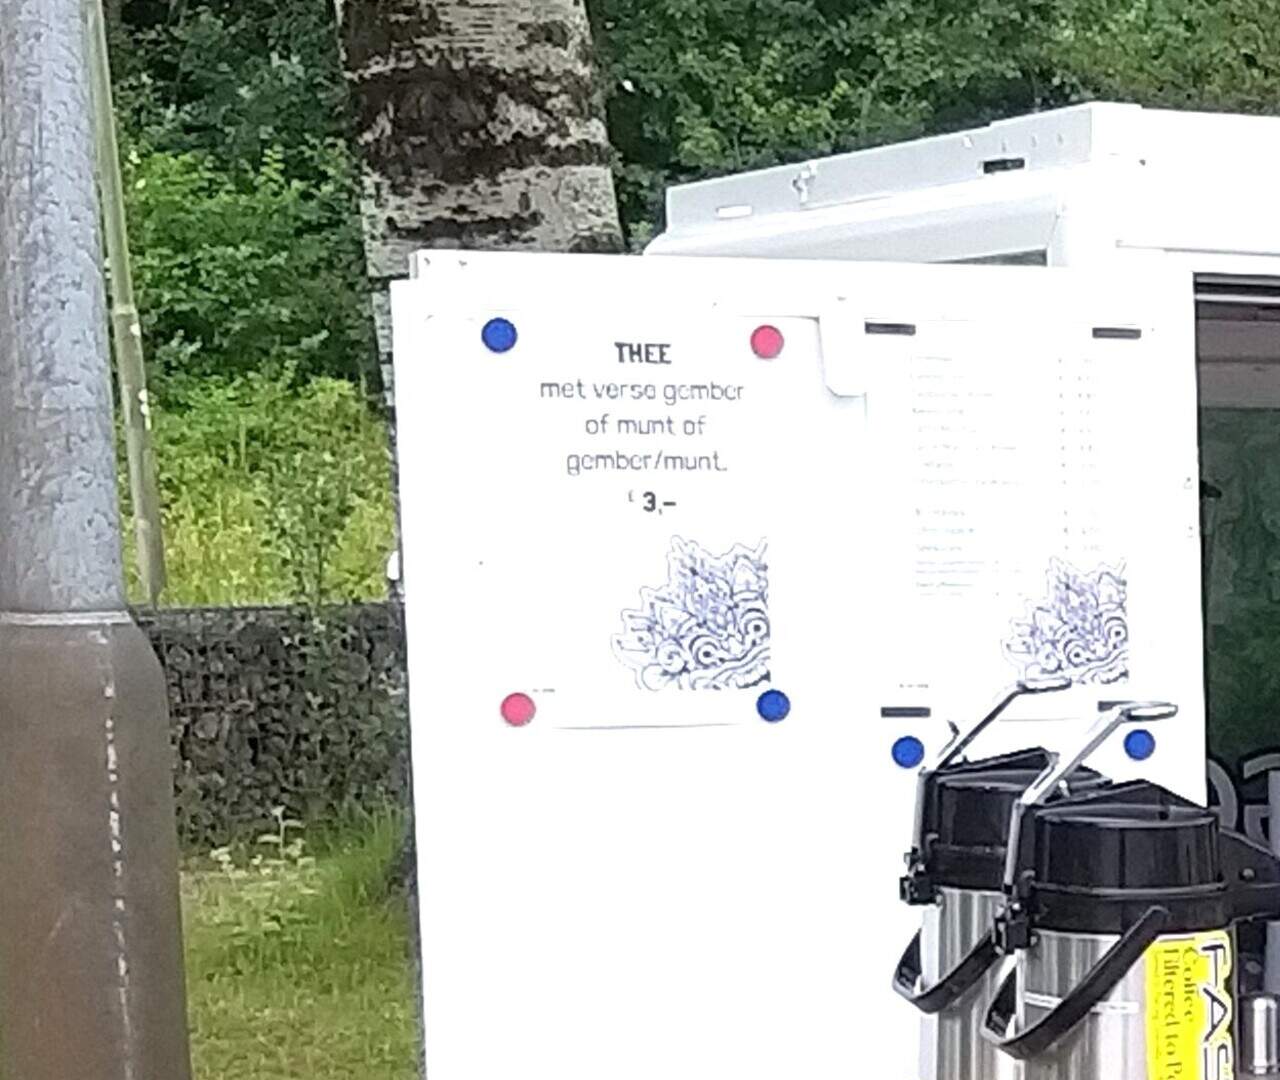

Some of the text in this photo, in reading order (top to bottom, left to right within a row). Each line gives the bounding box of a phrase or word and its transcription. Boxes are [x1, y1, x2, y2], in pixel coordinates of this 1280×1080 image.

[614, 341, 672, 364] THEE
[540, 378, 587, 399] met
[663, 381, 744, 406] gember
[585, 413, 707, 435] of munt of
[1163, 947, 1182, 1027] Filtered
[1183, 946, 1199, 1023] Coffee
[1164, 1033, 1180, 1056] to
